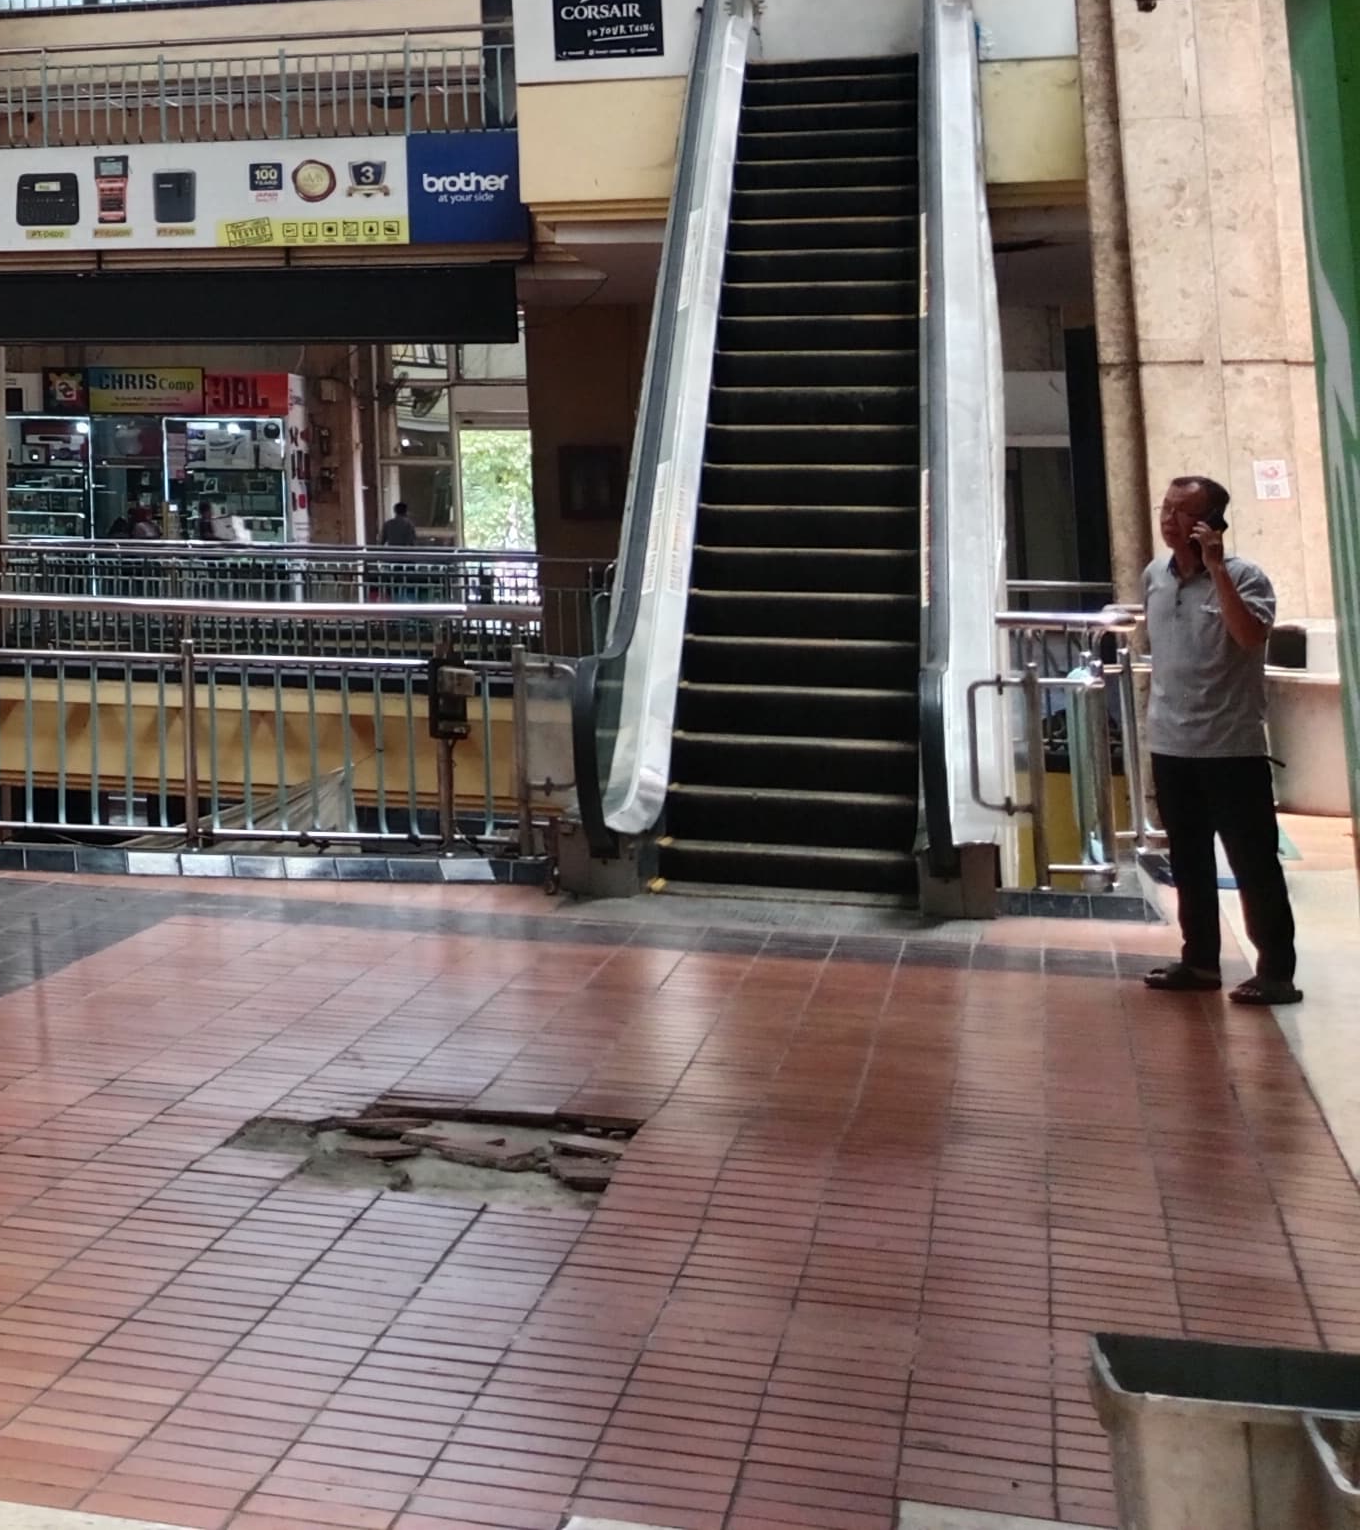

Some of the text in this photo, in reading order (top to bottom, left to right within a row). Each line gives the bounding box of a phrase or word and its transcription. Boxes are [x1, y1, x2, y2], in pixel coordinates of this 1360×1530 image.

[561, 3, 641, 20] CORSAIR
[422, 172, 509, 192] brother
[437, 191, 494, 205] at your side
[99, 373, 195, 393] CHRIS Comp
[212, 378, 269, 409] JBL
